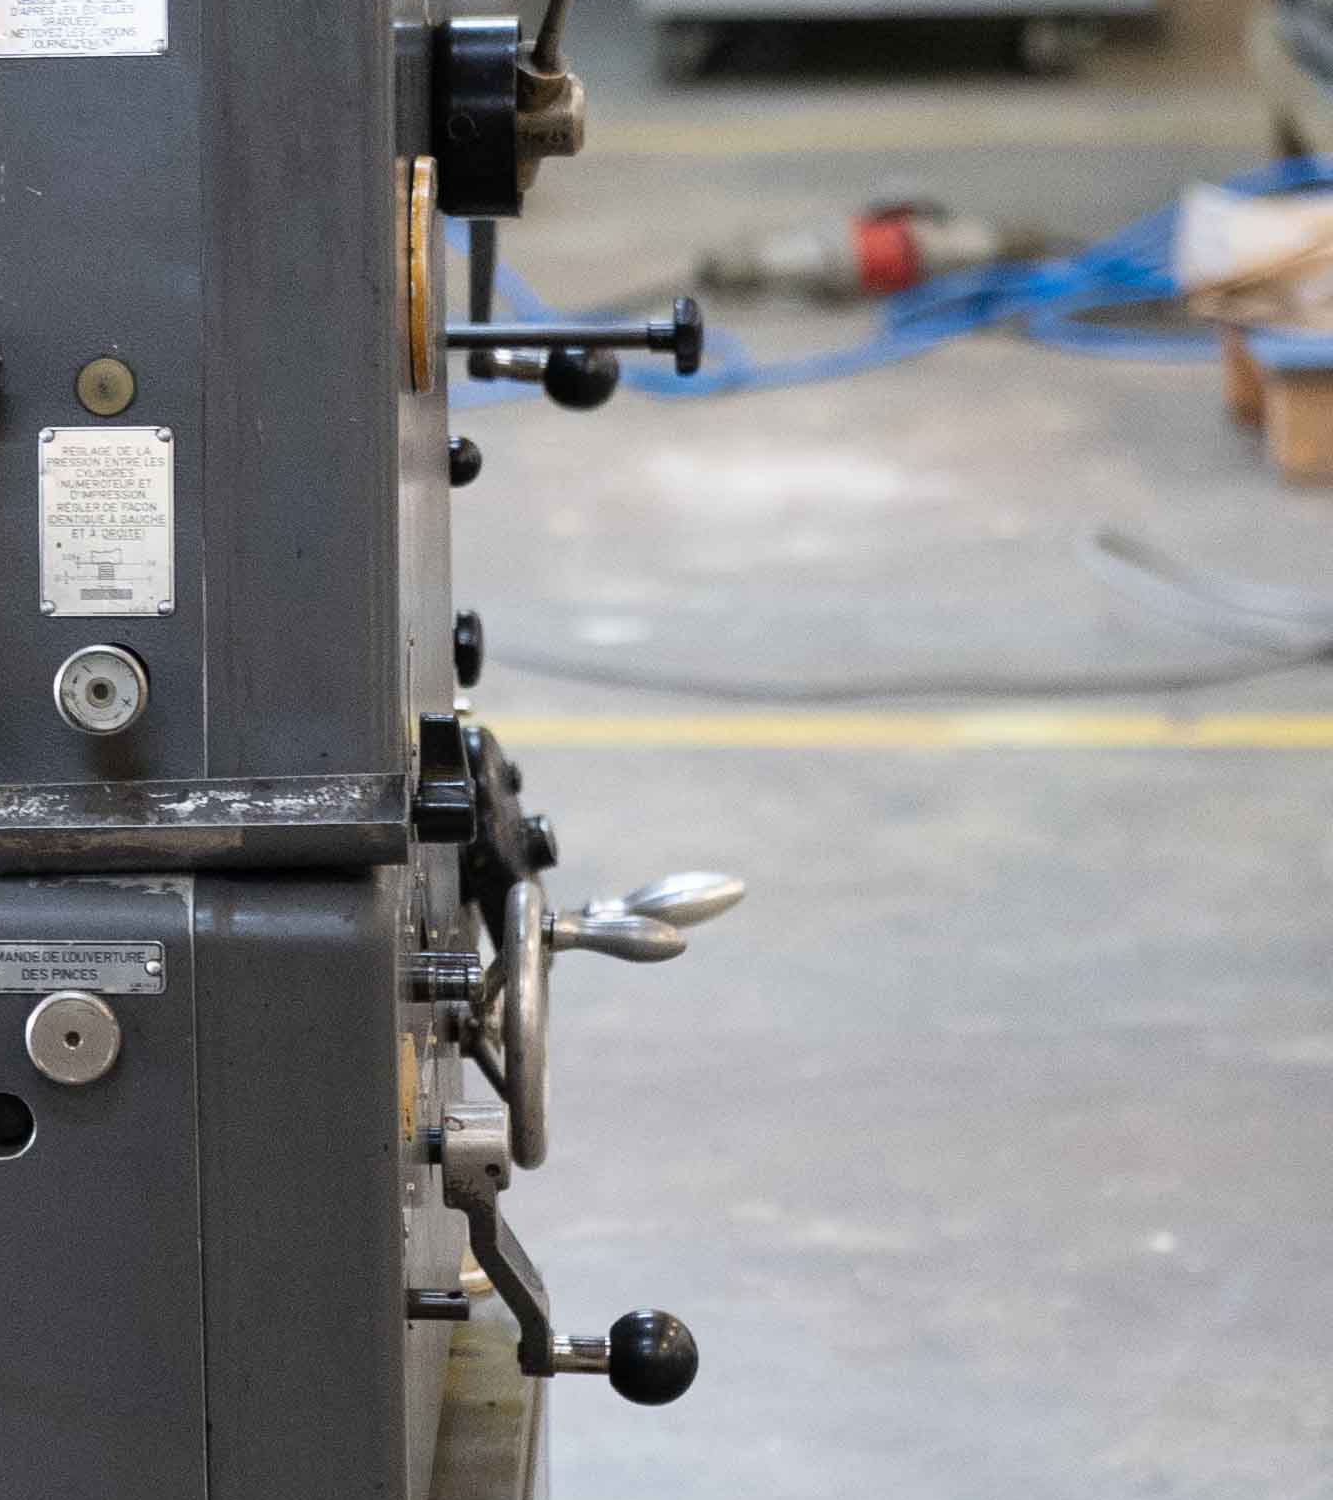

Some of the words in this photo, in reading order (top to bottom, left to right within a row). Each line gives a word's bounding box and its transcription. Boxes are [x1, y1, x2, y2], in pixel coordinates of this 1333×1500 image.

[116, 446, 133, 456] DE
[46, 457, 101, 467] PRESSION
[105, 457, 142, 467] ENTRE
[144, 456, 165, 467] LES
[139, 478, 152, 488] ET
[102, 502, 117, 512] DE
[71, 528, 85, 538] ET
[42, 951, 60, 963] DE
[21, 968, 49, 980] DES
[52, 968, 99, 980] PINCES
